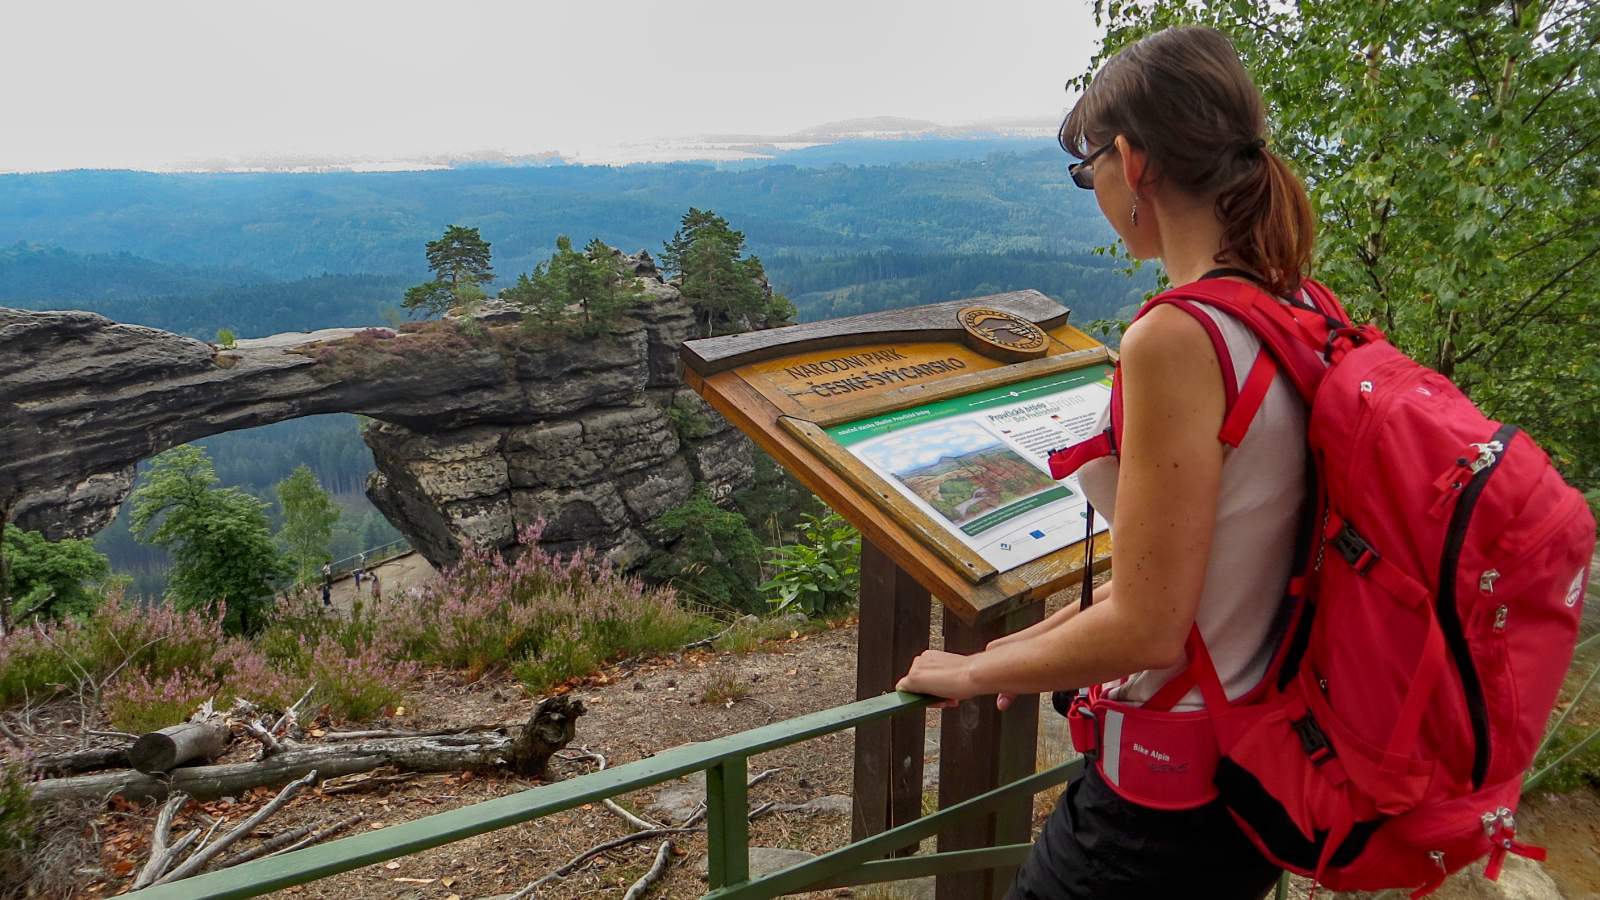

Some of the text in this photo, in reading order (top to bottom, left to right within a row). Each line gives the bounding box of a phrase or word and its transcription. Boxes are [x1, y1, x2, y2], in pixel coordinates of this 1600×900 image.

[860, 348, 908, 366] PARK
[807, 357, 967, 398] ČESKÉ ŠVÝCARSKO
[1133, 743, 1170, 762] Bike Alpin
